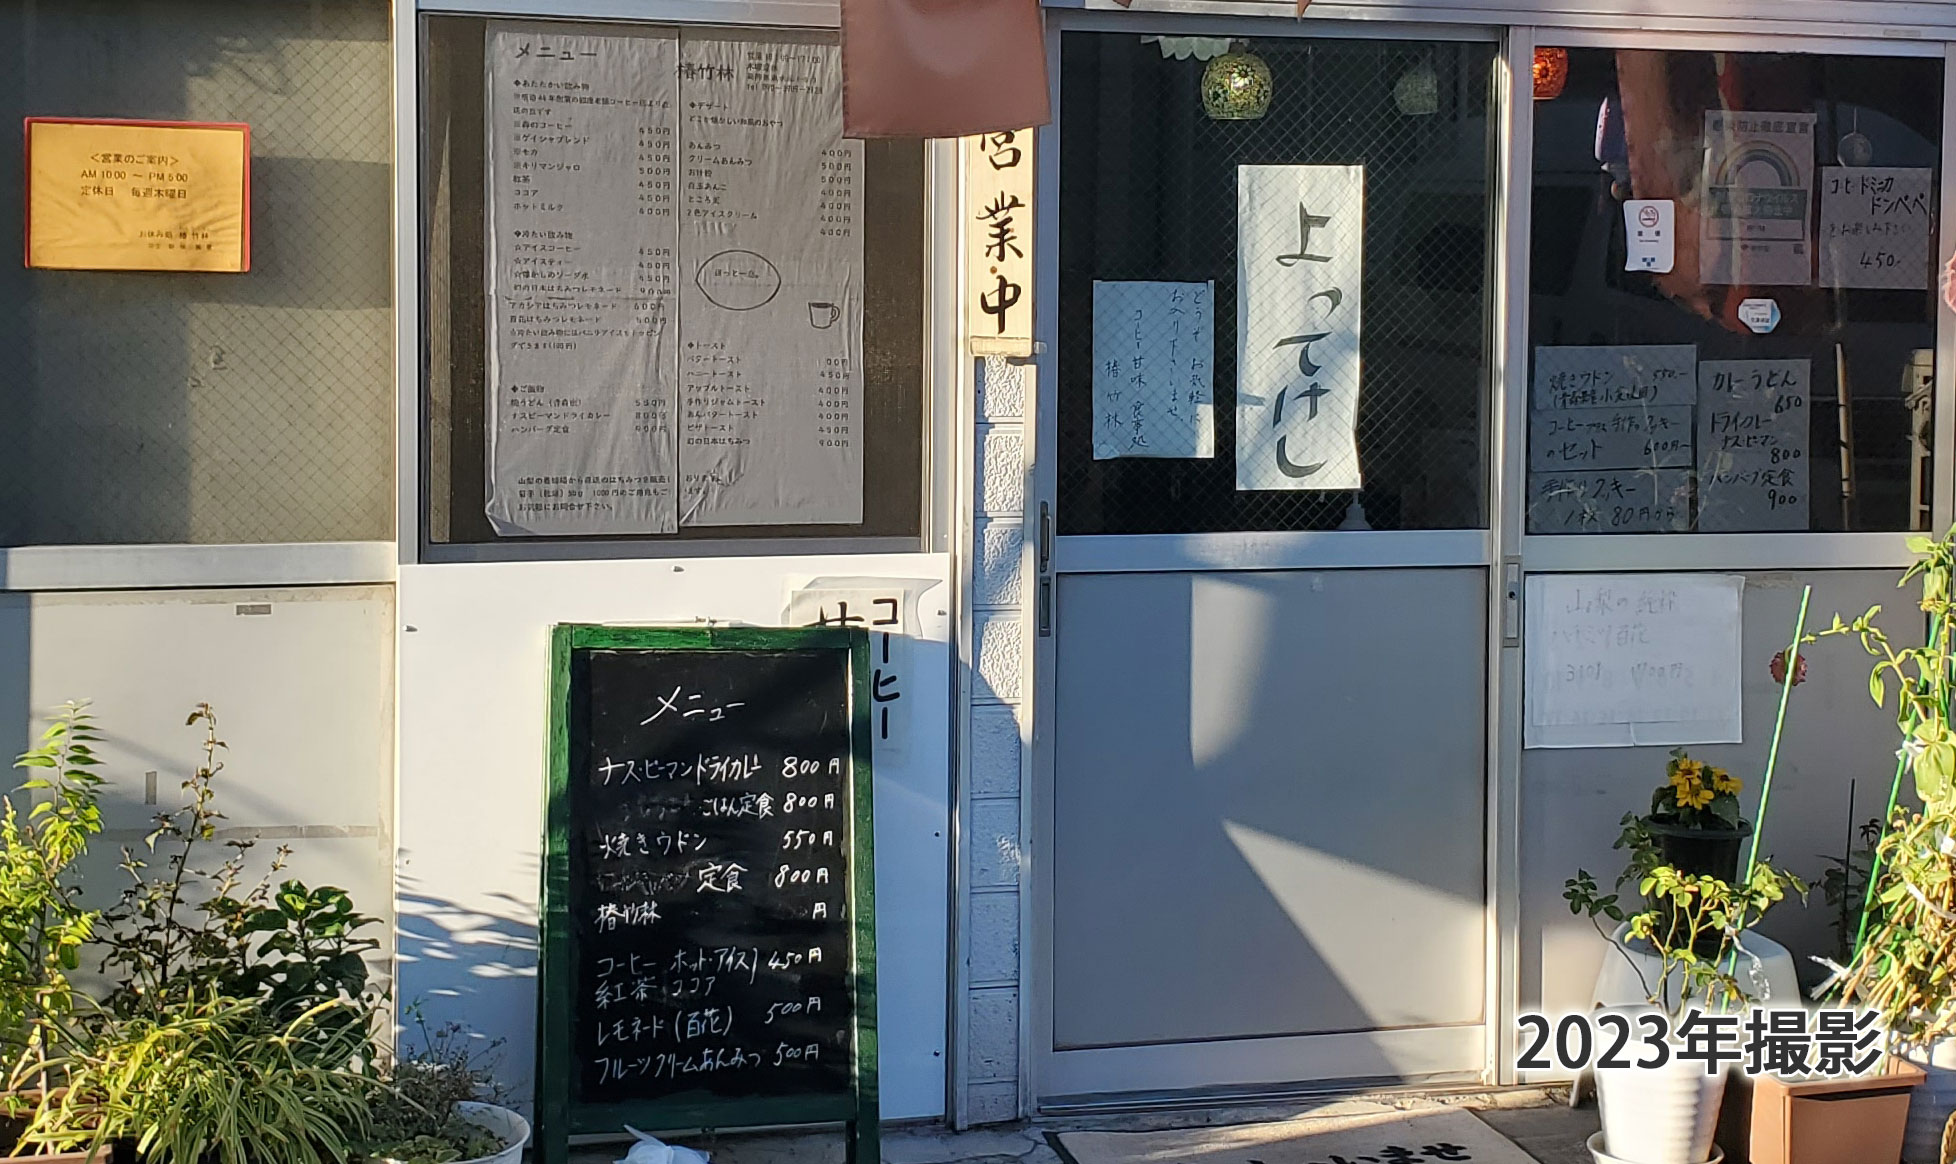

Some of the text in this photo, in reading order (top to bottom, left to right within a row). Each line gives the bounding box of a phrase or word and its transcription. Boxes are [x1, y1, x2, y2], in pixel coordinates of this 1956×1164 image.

[515, 43, 597, 61] メニュー
[674, 63, 734, 81] 椿竹林
[81, 169, 96, 179] AM
[149, 172, 165, 181] PM
[81, 186, 187, 199] 定休日 毎週木曜日
[514, 189, 539, 197] ココア
[1774, 396, 1802, 414] 650
[1770, 447, 1802, 464] 800
[1768, 490, 1798, 510] 900
[873, 598, 900, 740] コーヒー
[640, 685, 746, 726] メニュー
[781, 756, 840, 778] 800円
[700, 792, 775, 820] ごはん定食
[782, 792, 835, 814] 800円
[599, 829, 833, 859] 焼きウドン 550円
[696, 862, 748, 893] 定食
[774, 864, 830, 888] 800円
[812, 902, 828, 920] 円
[596, 952, 657, 978] コーヒー
[768, 947, 822, 970] 450円
[594, 976, 716, 1008] 紅茶 ココア
[596, 1016, 664, 1046] レモネード
[764, 996, 822, 1024] 500円
[773, 1042, 820, 1068] 500円
